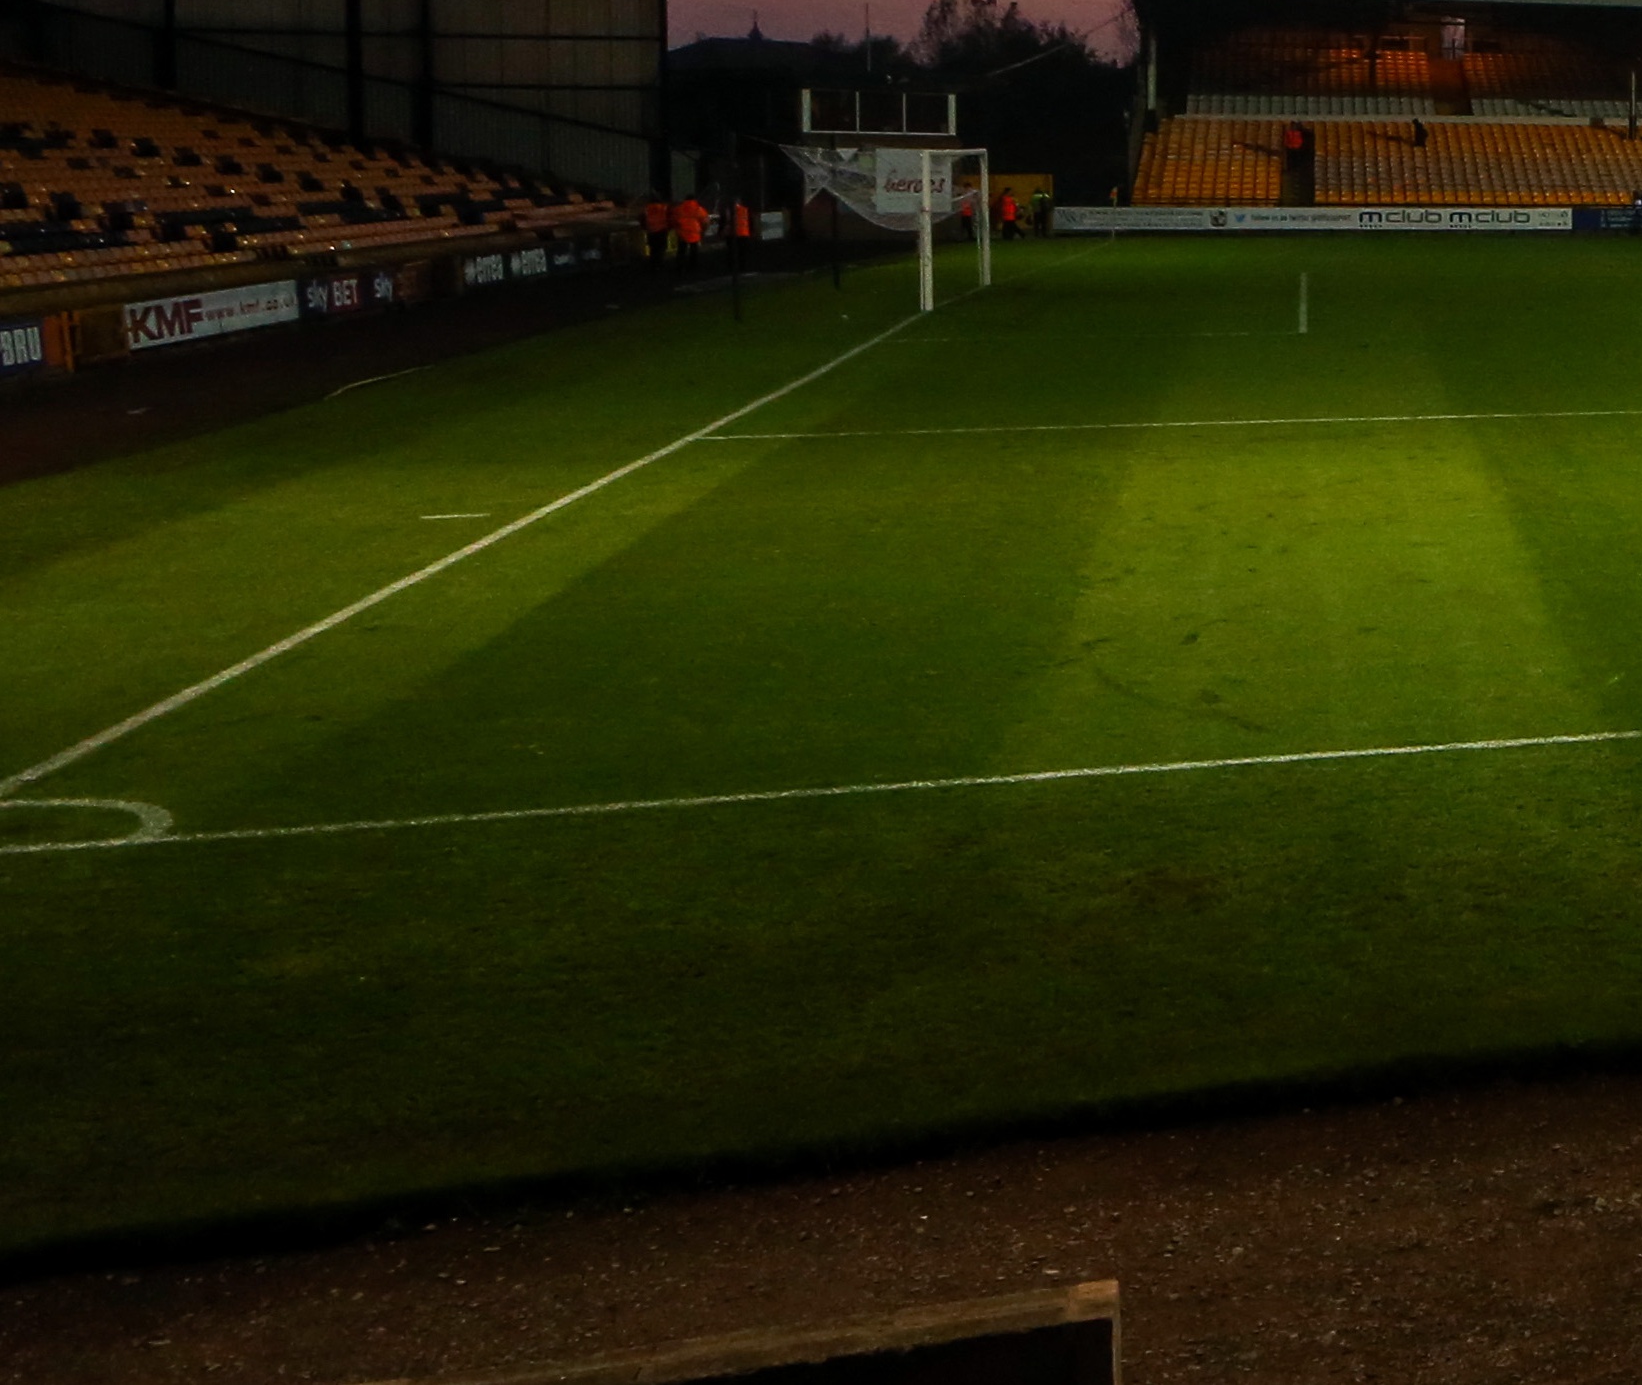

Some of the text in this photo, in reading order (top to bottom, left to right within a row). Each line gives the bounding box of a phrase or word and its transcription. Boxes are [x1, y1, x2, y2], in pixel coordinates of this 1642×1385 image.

[307, 279, 329, 313] sky
[333, 278, 360, 306] BET
[373, 271, 394, 303] sky
[129, 298, 205, 343] KMF
[0, 325, 43, 366] BRU
